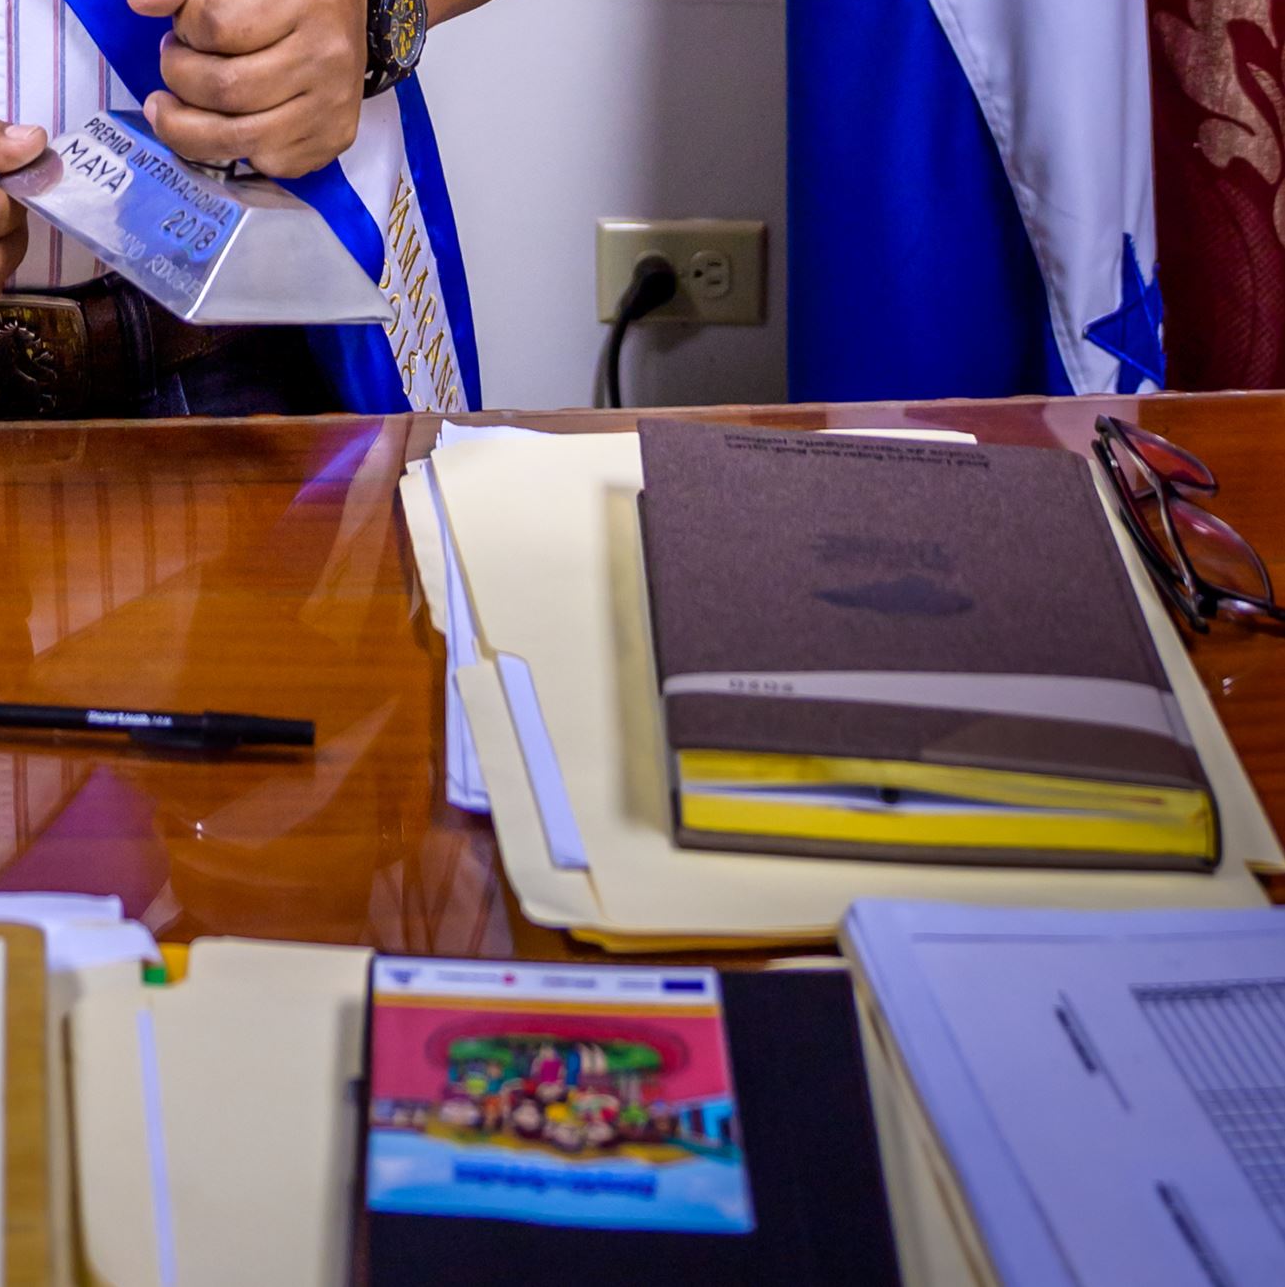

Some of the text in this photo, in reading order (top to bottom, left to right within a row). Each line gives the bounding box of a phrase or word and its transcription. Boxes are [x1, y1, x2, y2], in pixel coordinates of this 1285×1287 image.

[60, 139, 126, 195] MAYA
[84, 117, 234, 226] PREMIO INTERNACIONAL
[162, 210, 216, 252] 2018
